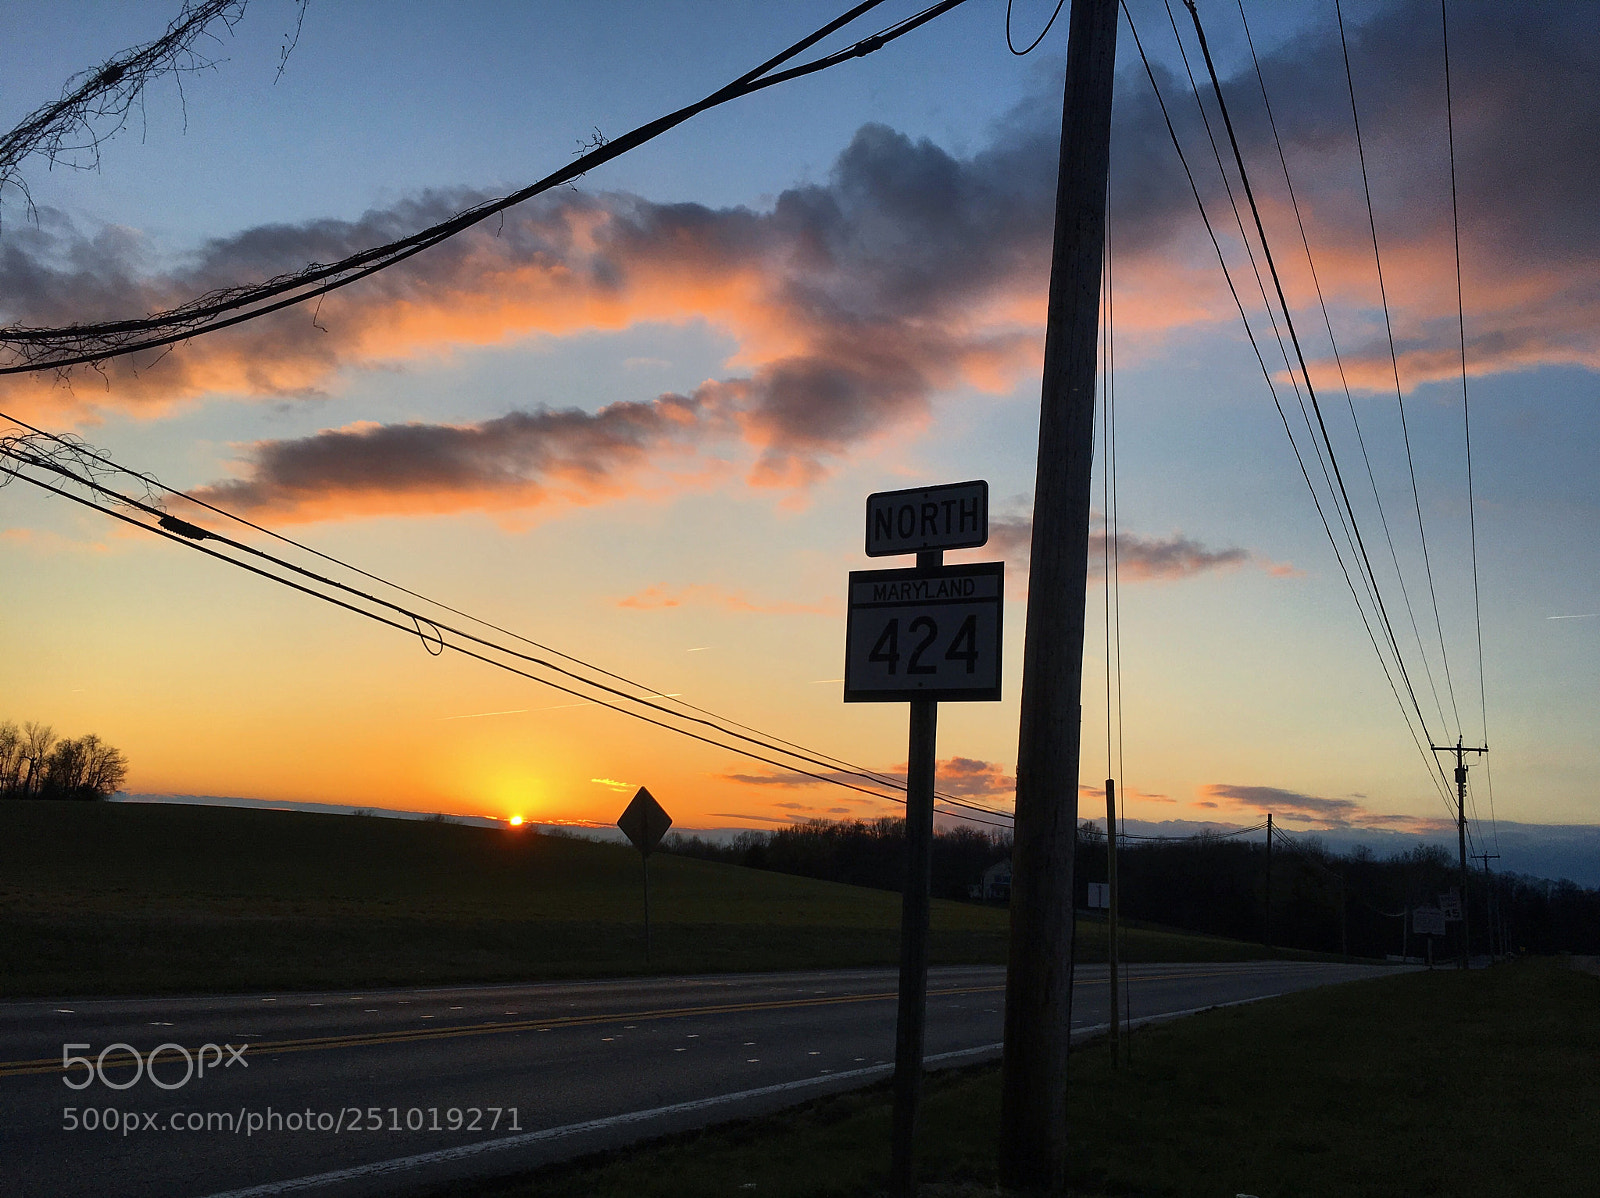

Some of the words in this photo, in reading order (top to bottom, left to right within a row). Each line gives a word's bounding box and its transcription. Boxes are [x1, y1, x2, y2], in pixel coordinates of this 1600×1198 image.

[875, 497, 978, 541] NORTH
[873, 578, 975, 601] MARYLAND
[869, 614, 979, 675] 424
